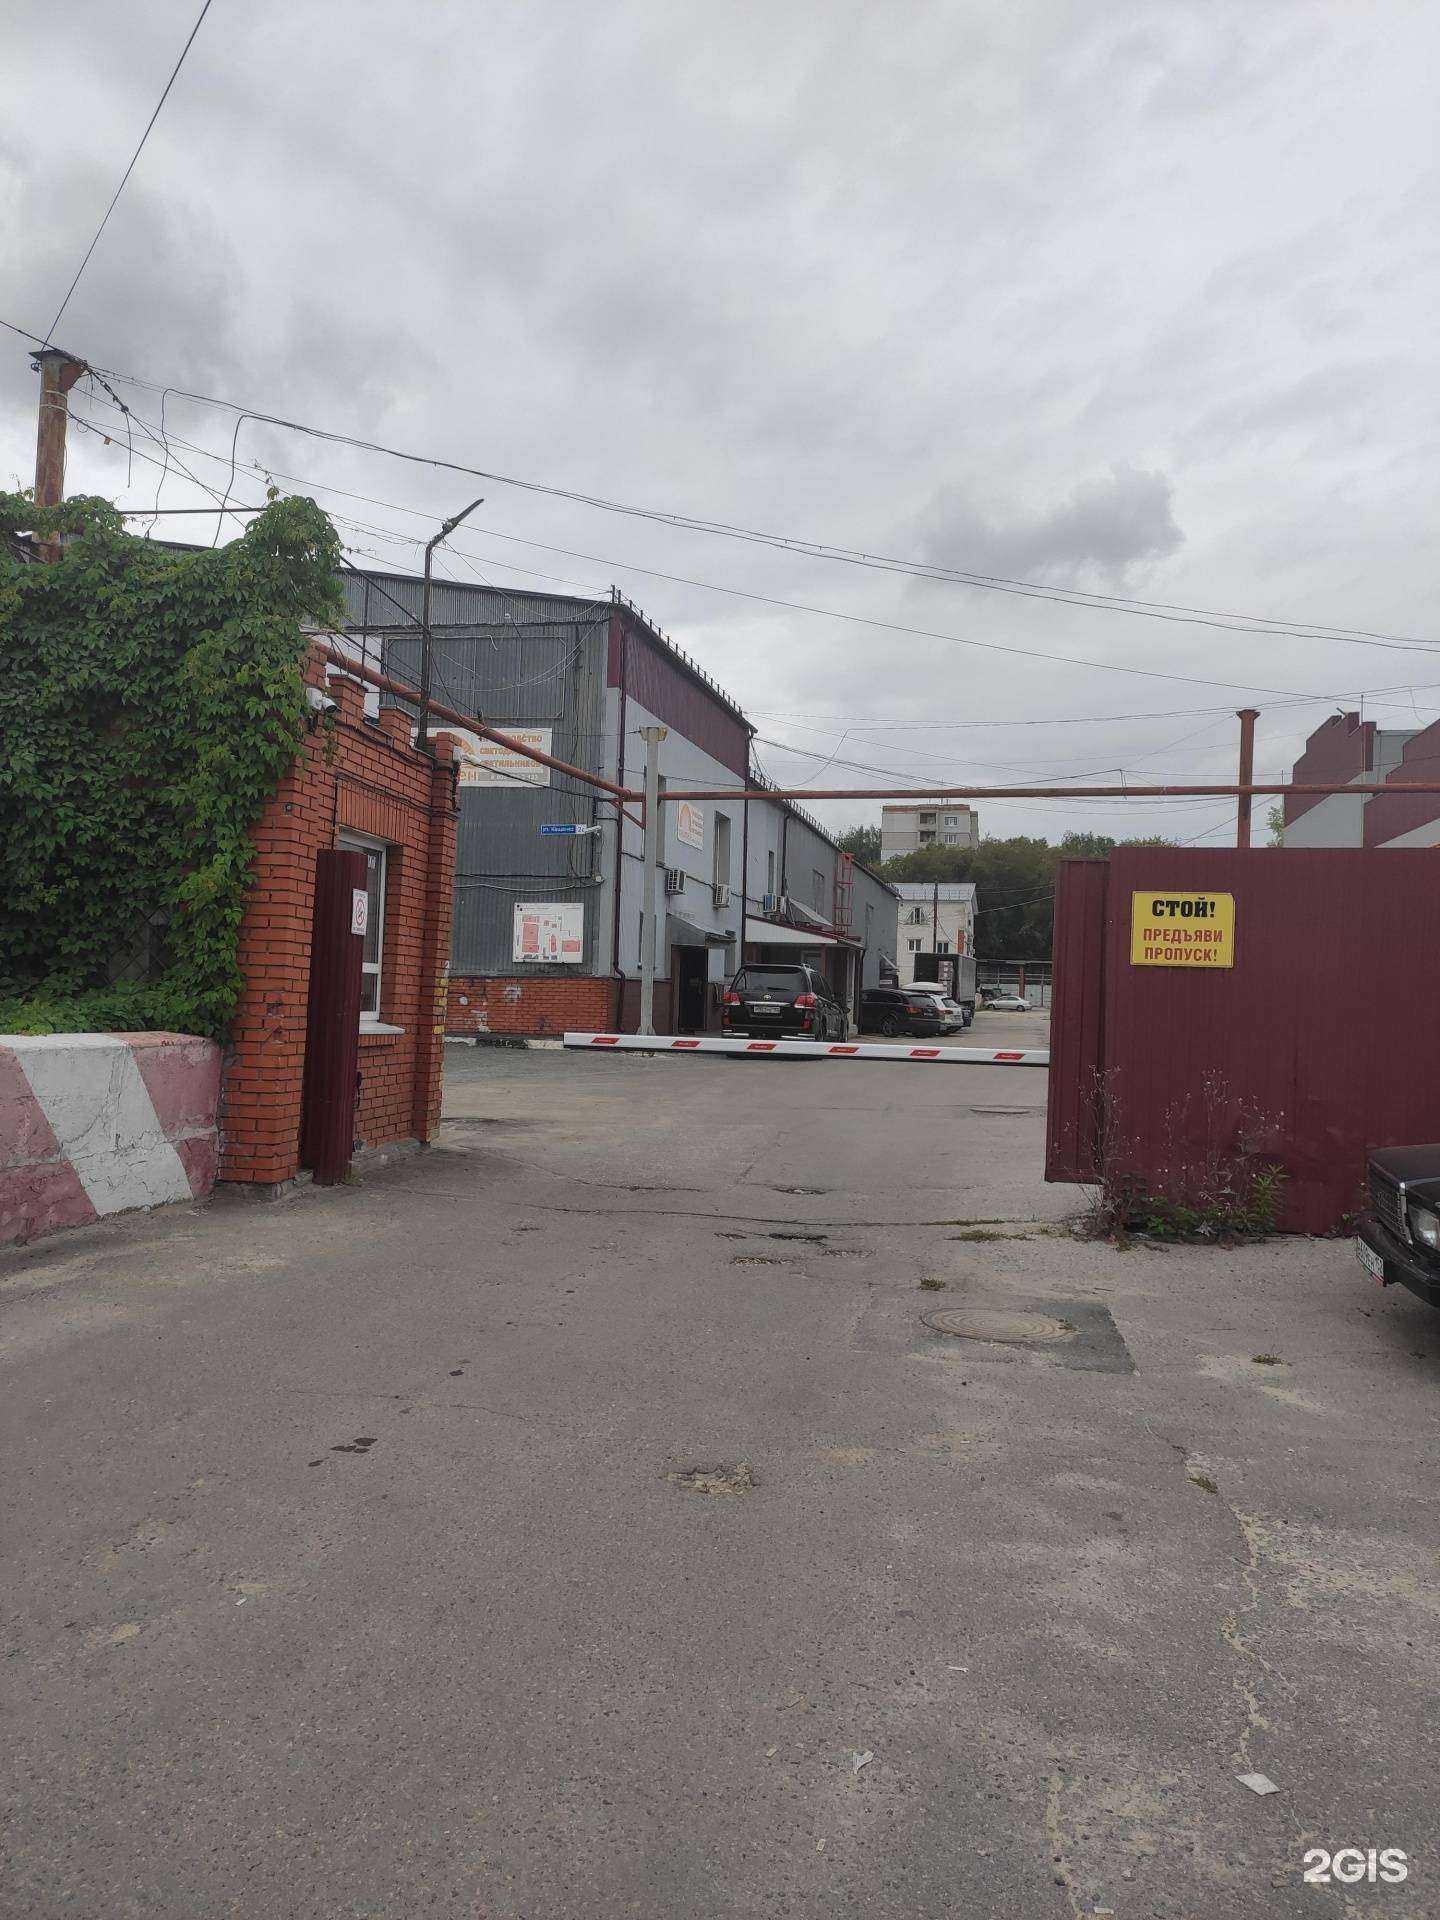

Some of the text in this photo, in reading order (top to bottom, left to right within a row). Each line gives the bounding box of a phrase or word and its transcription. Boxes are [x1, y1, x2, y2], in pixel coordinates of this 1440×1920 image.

[1152, 896, 1216, 918] СТОЙ!
[1143, 928, 1223, 944] ПРЕДЪЯВИ
[1144, 946, 1218, 962] ПРОПУСК!
